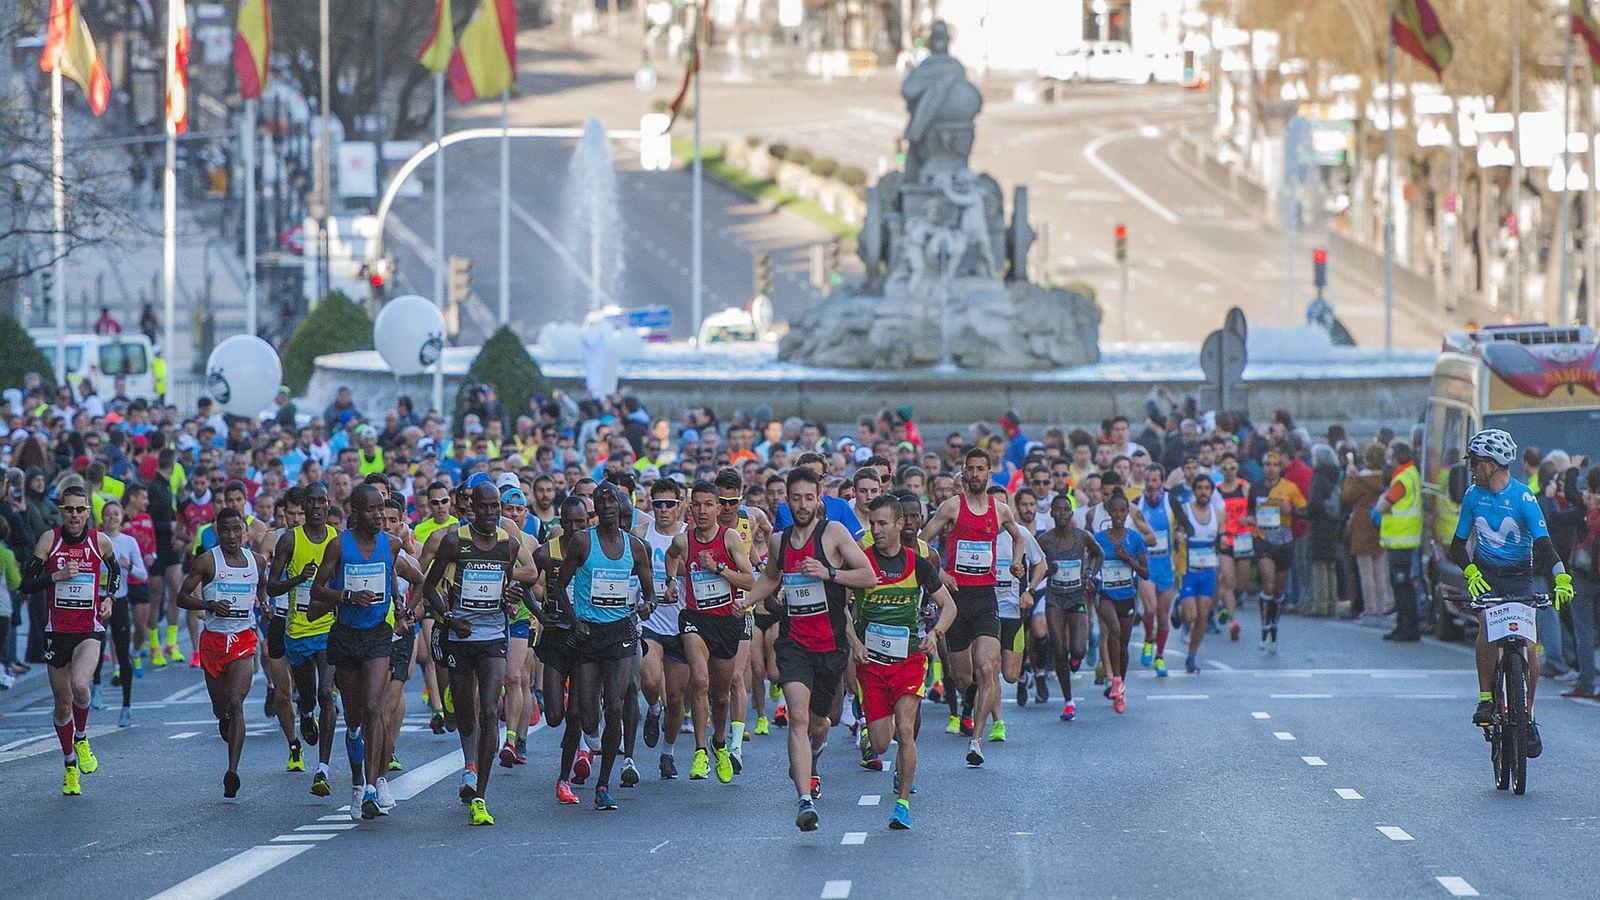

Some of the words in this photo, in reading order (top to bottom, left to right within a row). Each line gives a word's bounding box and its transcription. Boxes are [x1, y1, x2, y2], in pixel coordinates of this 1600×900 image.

[363, 579, 368, 587] 7
[609, 583, 614, 591] 5
[478, 585, 488, 593] 40
[795, 589, 810, 597] 186
[232, 596, 237, 604] 9
[881, 640, 891, 648] 59
